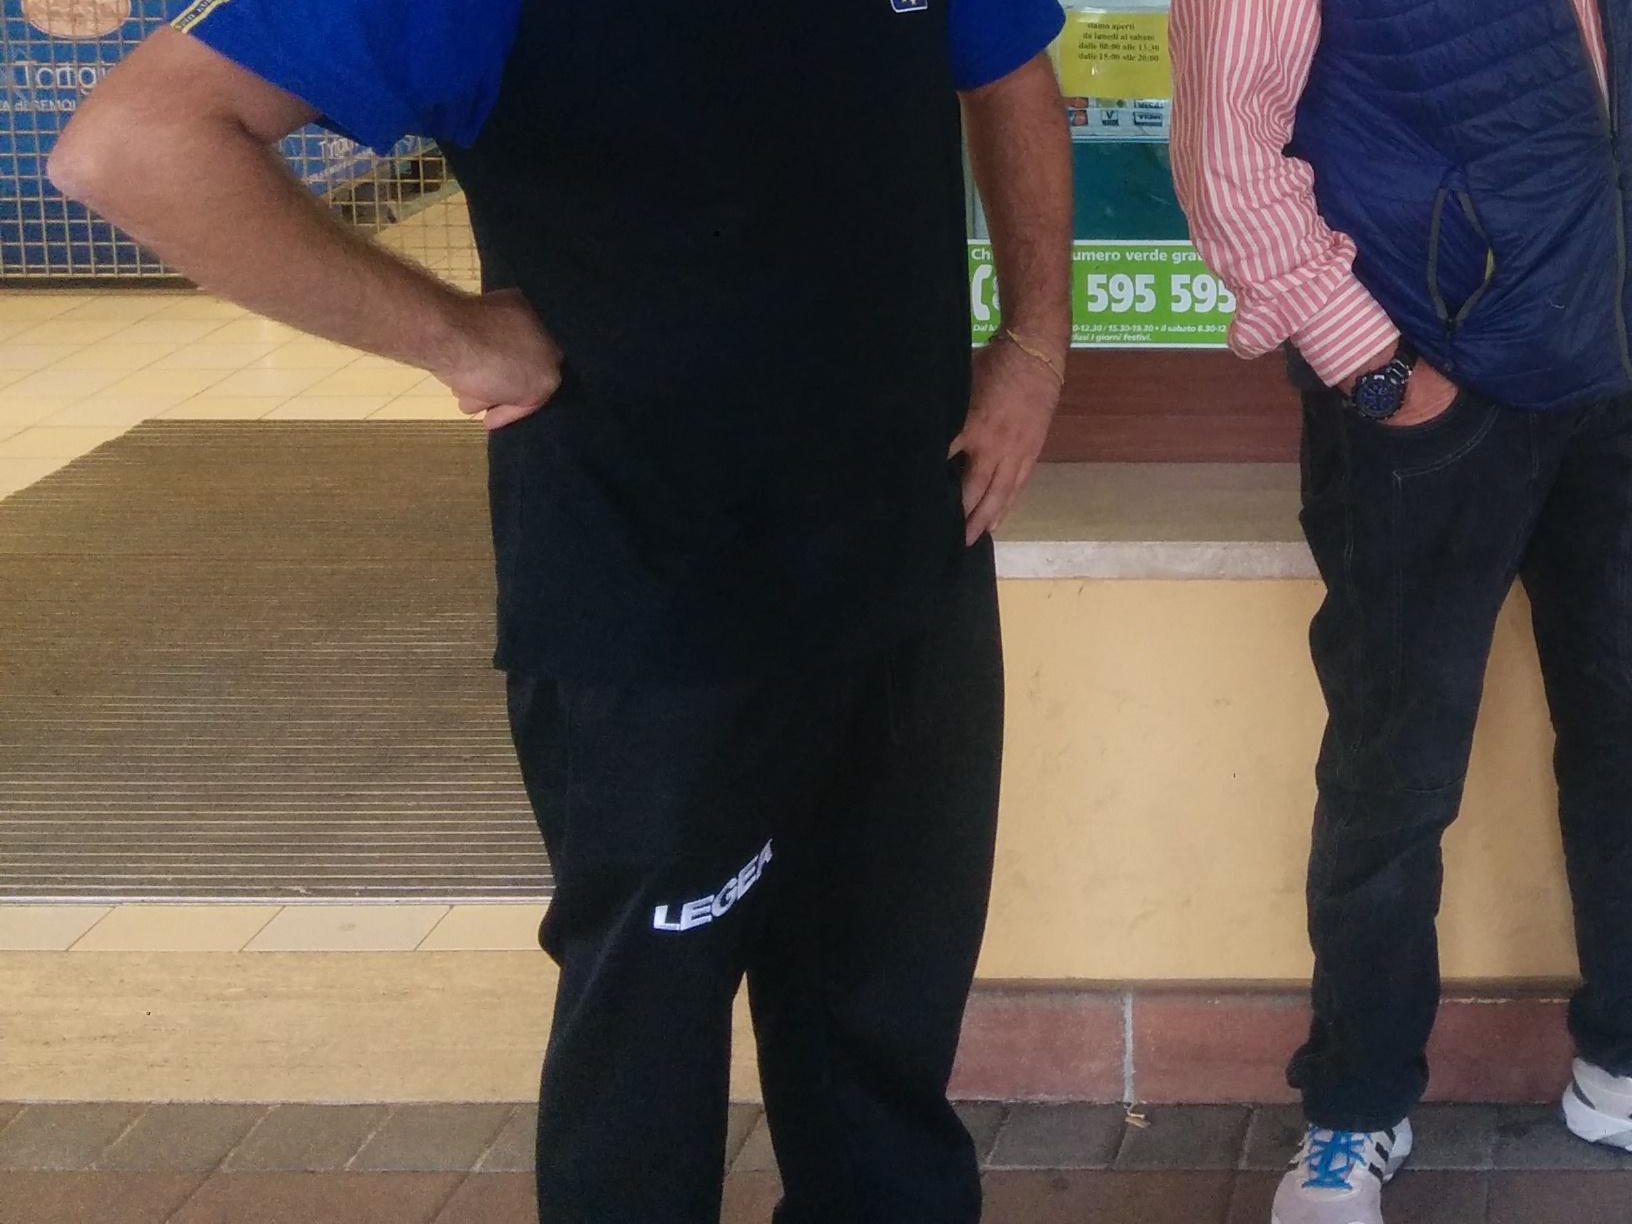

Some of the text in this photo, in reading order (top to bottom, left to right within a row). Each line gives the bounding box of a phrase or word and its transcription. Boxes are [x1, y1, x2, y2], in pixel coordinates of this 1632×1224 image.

[1072, 250, 1120, 261] umero
[1125, 249, 1168, 261] verde
[1087, 273, 1237, 313] 595 595
